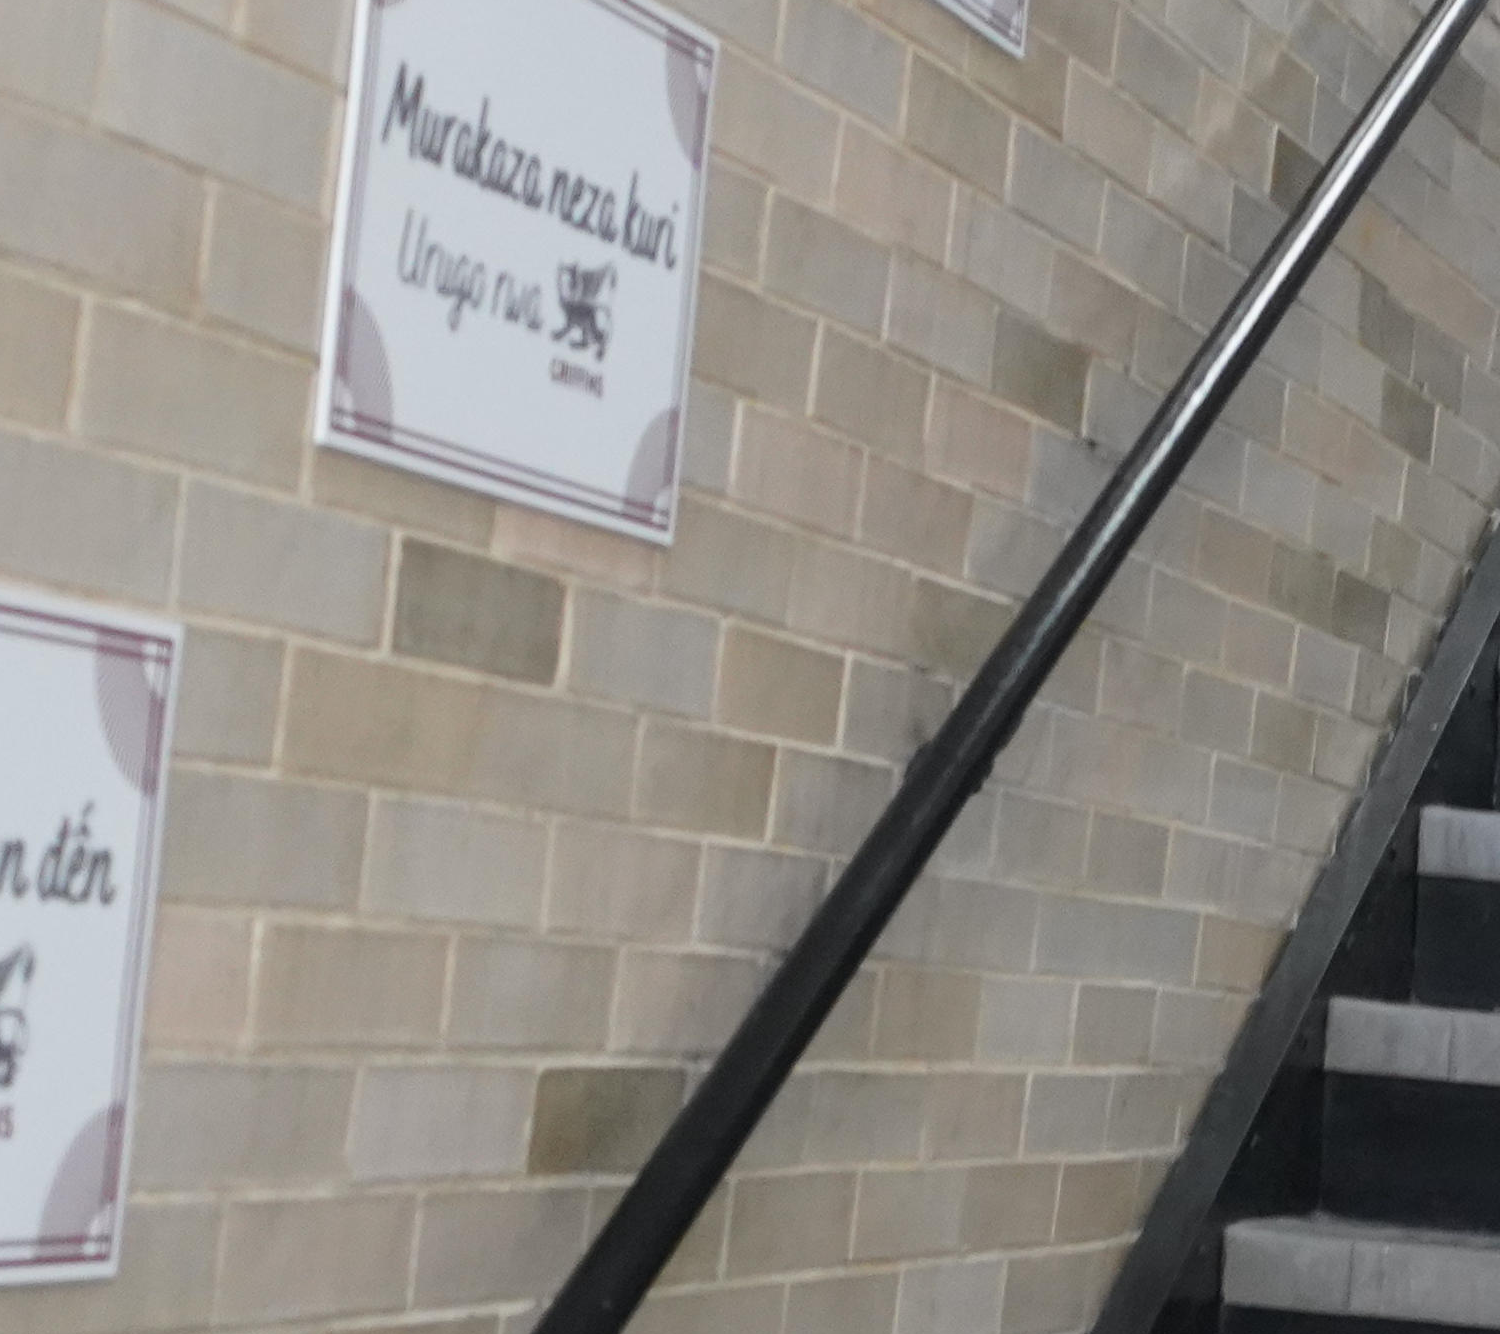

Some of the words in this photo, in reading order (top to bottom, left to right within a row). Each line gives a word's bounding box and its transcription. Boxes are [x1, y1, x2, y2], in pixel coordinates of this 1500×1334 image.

[380, 61, 543, 210] Murakaza
[546, 168, 618, 243] neza
[621, 170, 679, 271] kuri
[396, 208, 485, 333] Urugo
[490, 270, 543, 333] rwa
[36, 801, 116, 907] đến
